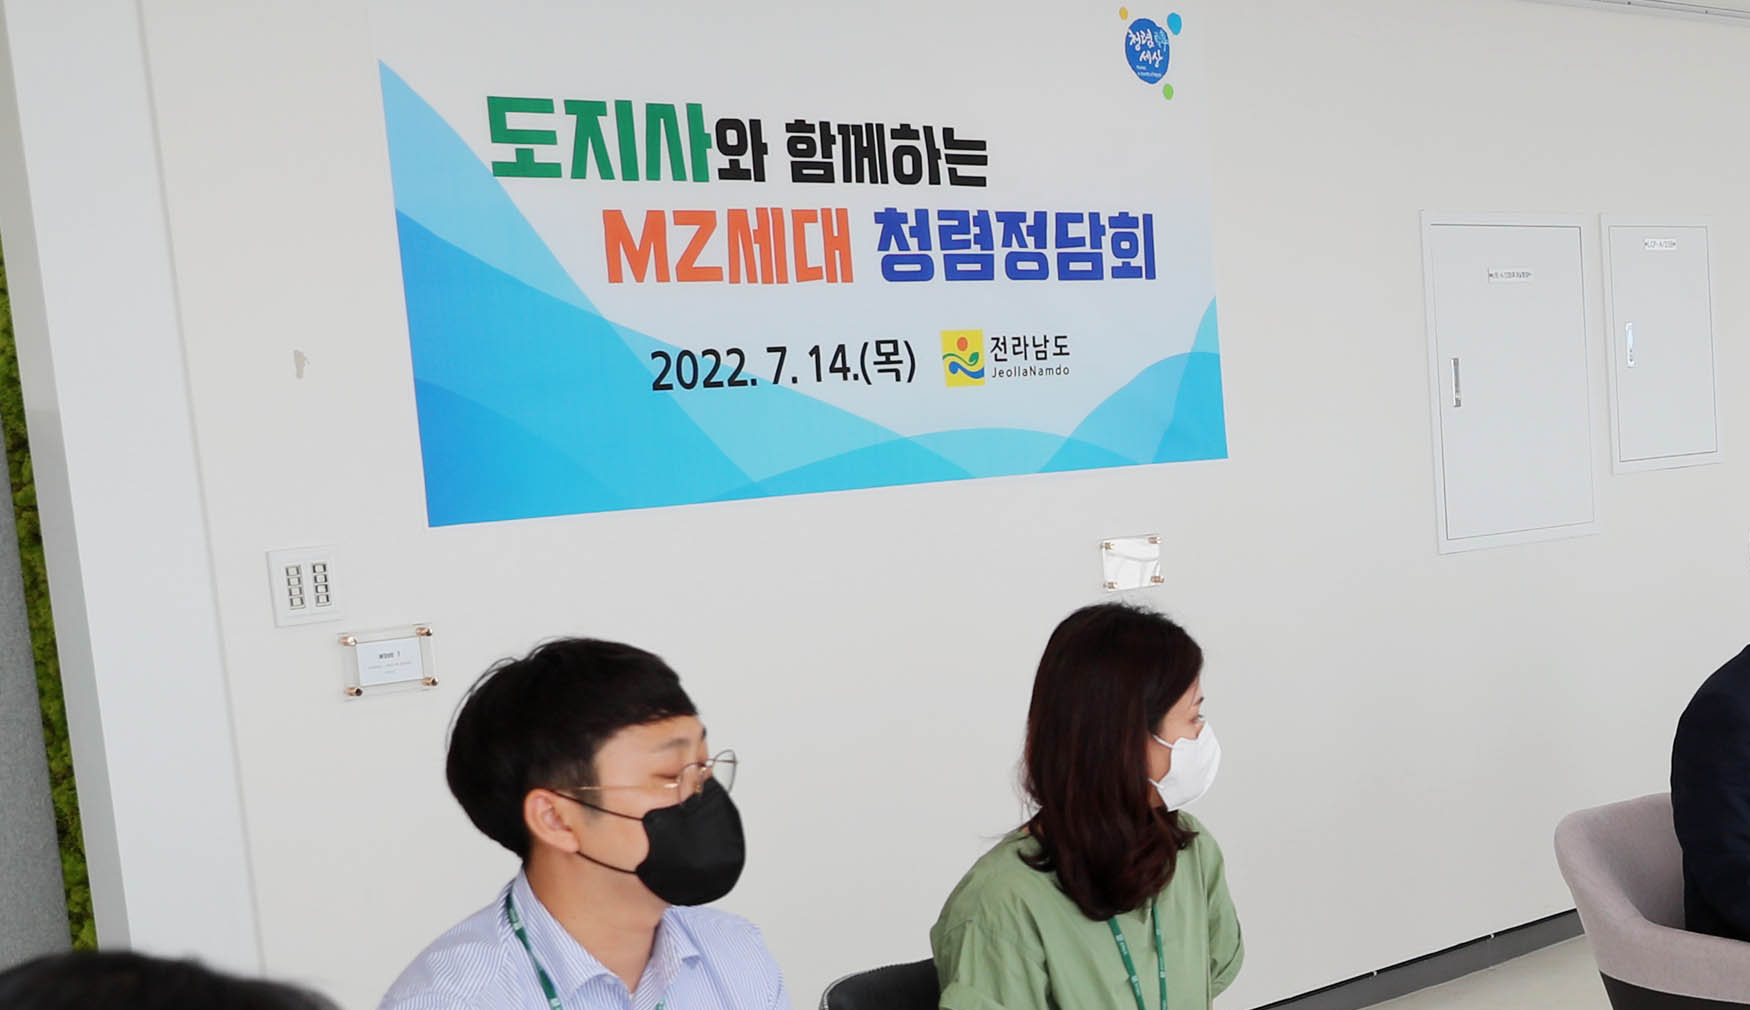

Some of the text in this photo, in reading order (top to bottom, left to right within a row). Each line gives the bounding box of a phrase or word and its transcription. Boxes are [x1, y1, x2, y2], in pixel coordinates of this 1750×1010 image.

[486, 95, 988, 188] 도지사와 함께하는
[601, 206, 1157, 285] MZ세대 청렴정담회
[650, 347, 758, 391] 2022.
[990, 334, 1070, 362] 전라남도
[991, 364, 1070, 378] JeollaNamdo
